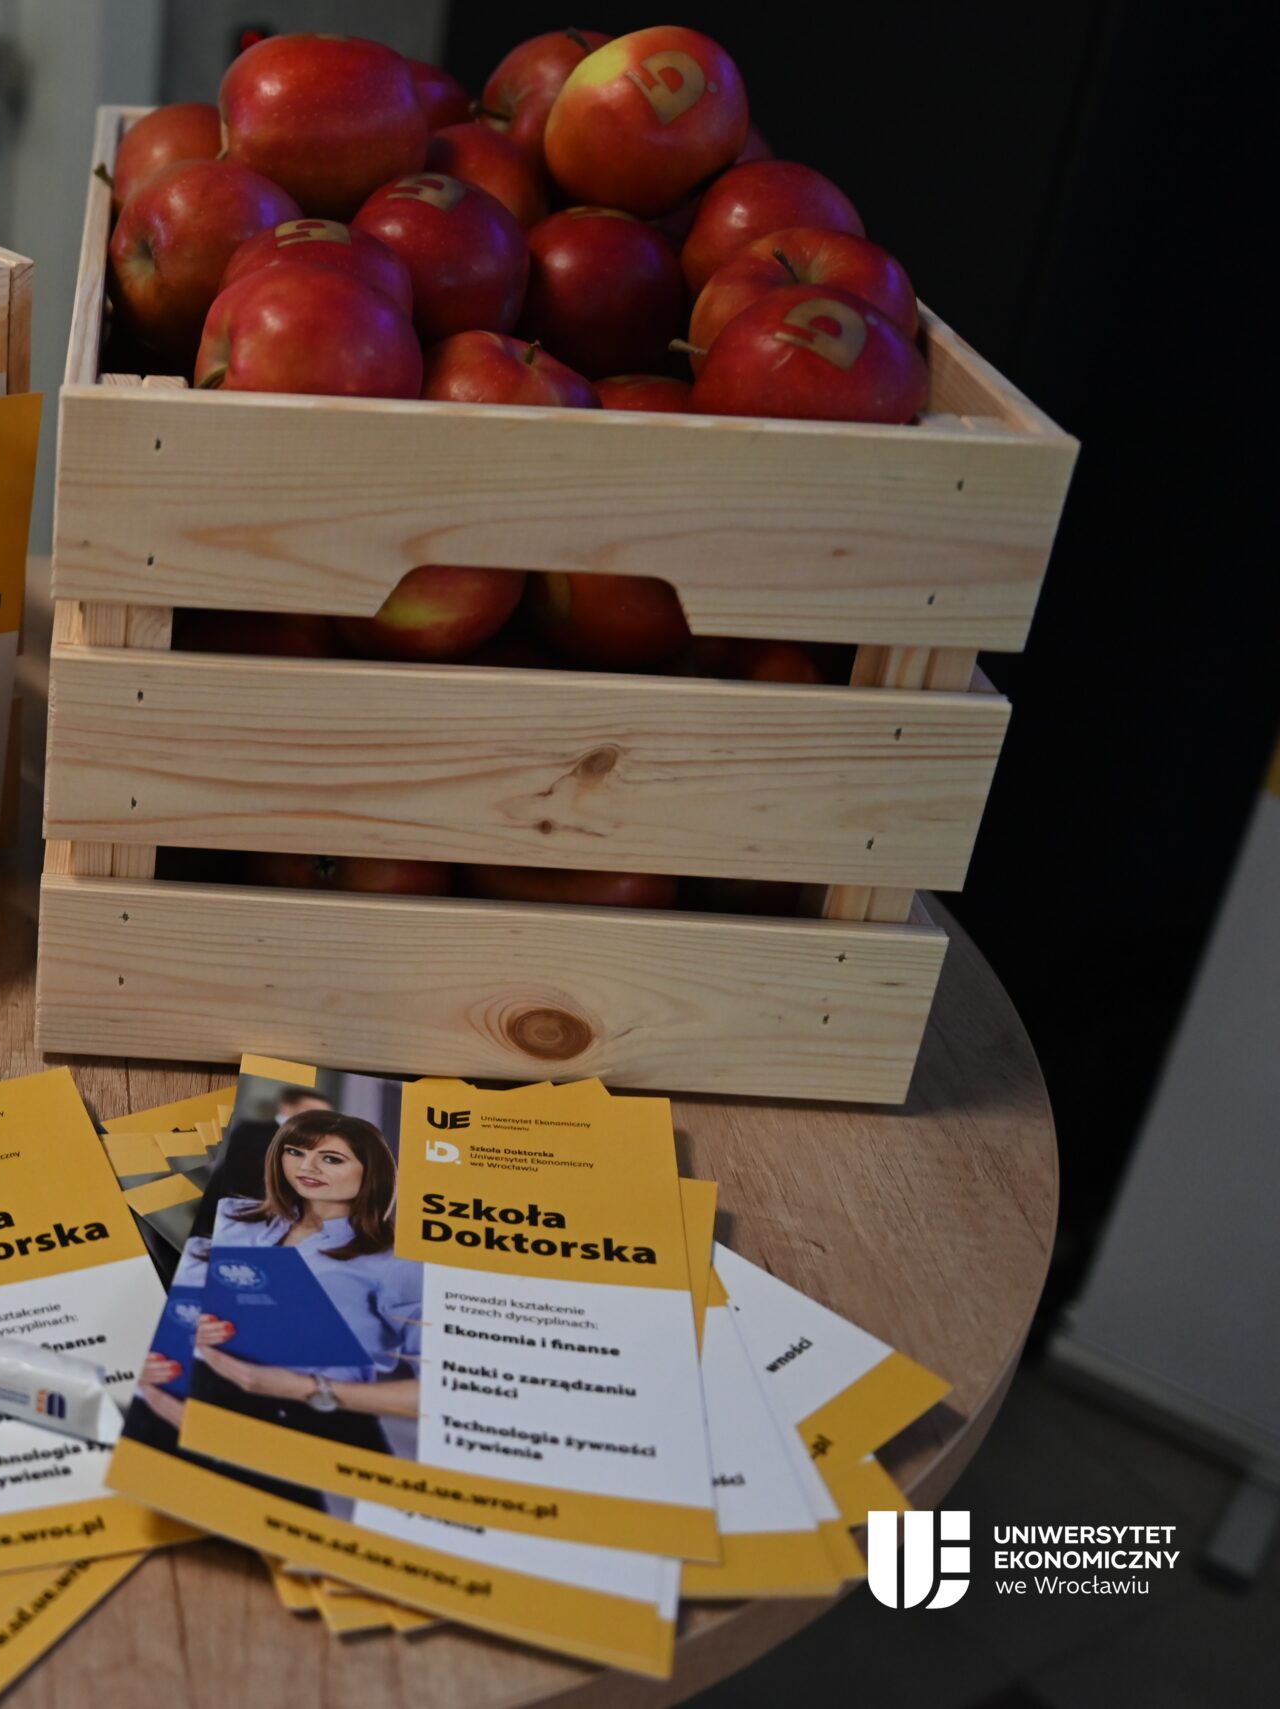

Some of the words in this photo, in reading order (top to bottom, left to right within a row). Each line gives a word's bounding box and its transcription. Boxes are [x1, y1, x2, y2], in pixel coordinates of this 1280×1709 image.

[427, 1106, 471, 1129] UE
[481, 1115, 532, 1126] Uniwersytet
[535, 1119, 591, 1129] Ekonomiczny
[470, 1145, 501, 1154] Szkoła
[504, 1148, 554, 1158] Doktorska
[470, 1153, 528, 1165] Uniwersytet
[531, 1158, 594, 1169] Ekonomiczny
[487, 1162, 539, 1172] Wrocławiu
[422, 1193, 566, 1230] Szkoła
[422, 1219, 657, 1264] Doktorska
[444, 1290, 507, 1307] prowadzi
[510, 1299, 585, 1315] kształcenie
[444, 1304, 456, 1312] w
[461, 1306, 502, 1319] trzech
[505, 1310, 599, 1330] dyscyplinach:
[444, 1324, 536, 1347] Ekonomia
[552, 1338, 620, 1356] finanse
[766, 1336, 813, 1373] wności
[443, 1361, 498, 1379] Nauki
[503, 1371, 514, 1381] o
[519, 1375, 637, 1397] zarządzaniu
[451, 1377, 518, 1399] jakości
[442, 1415, 560, 1446] Technologia
[566, 1431, 656, 1457] żywności
[457, 1435, 543, 1460] żywienia
[336, 1462, 558, 1519] www.sd.ue.wroc.pl
[266, 1516, 491, 1596] www.sd.ue.wroc.pl
